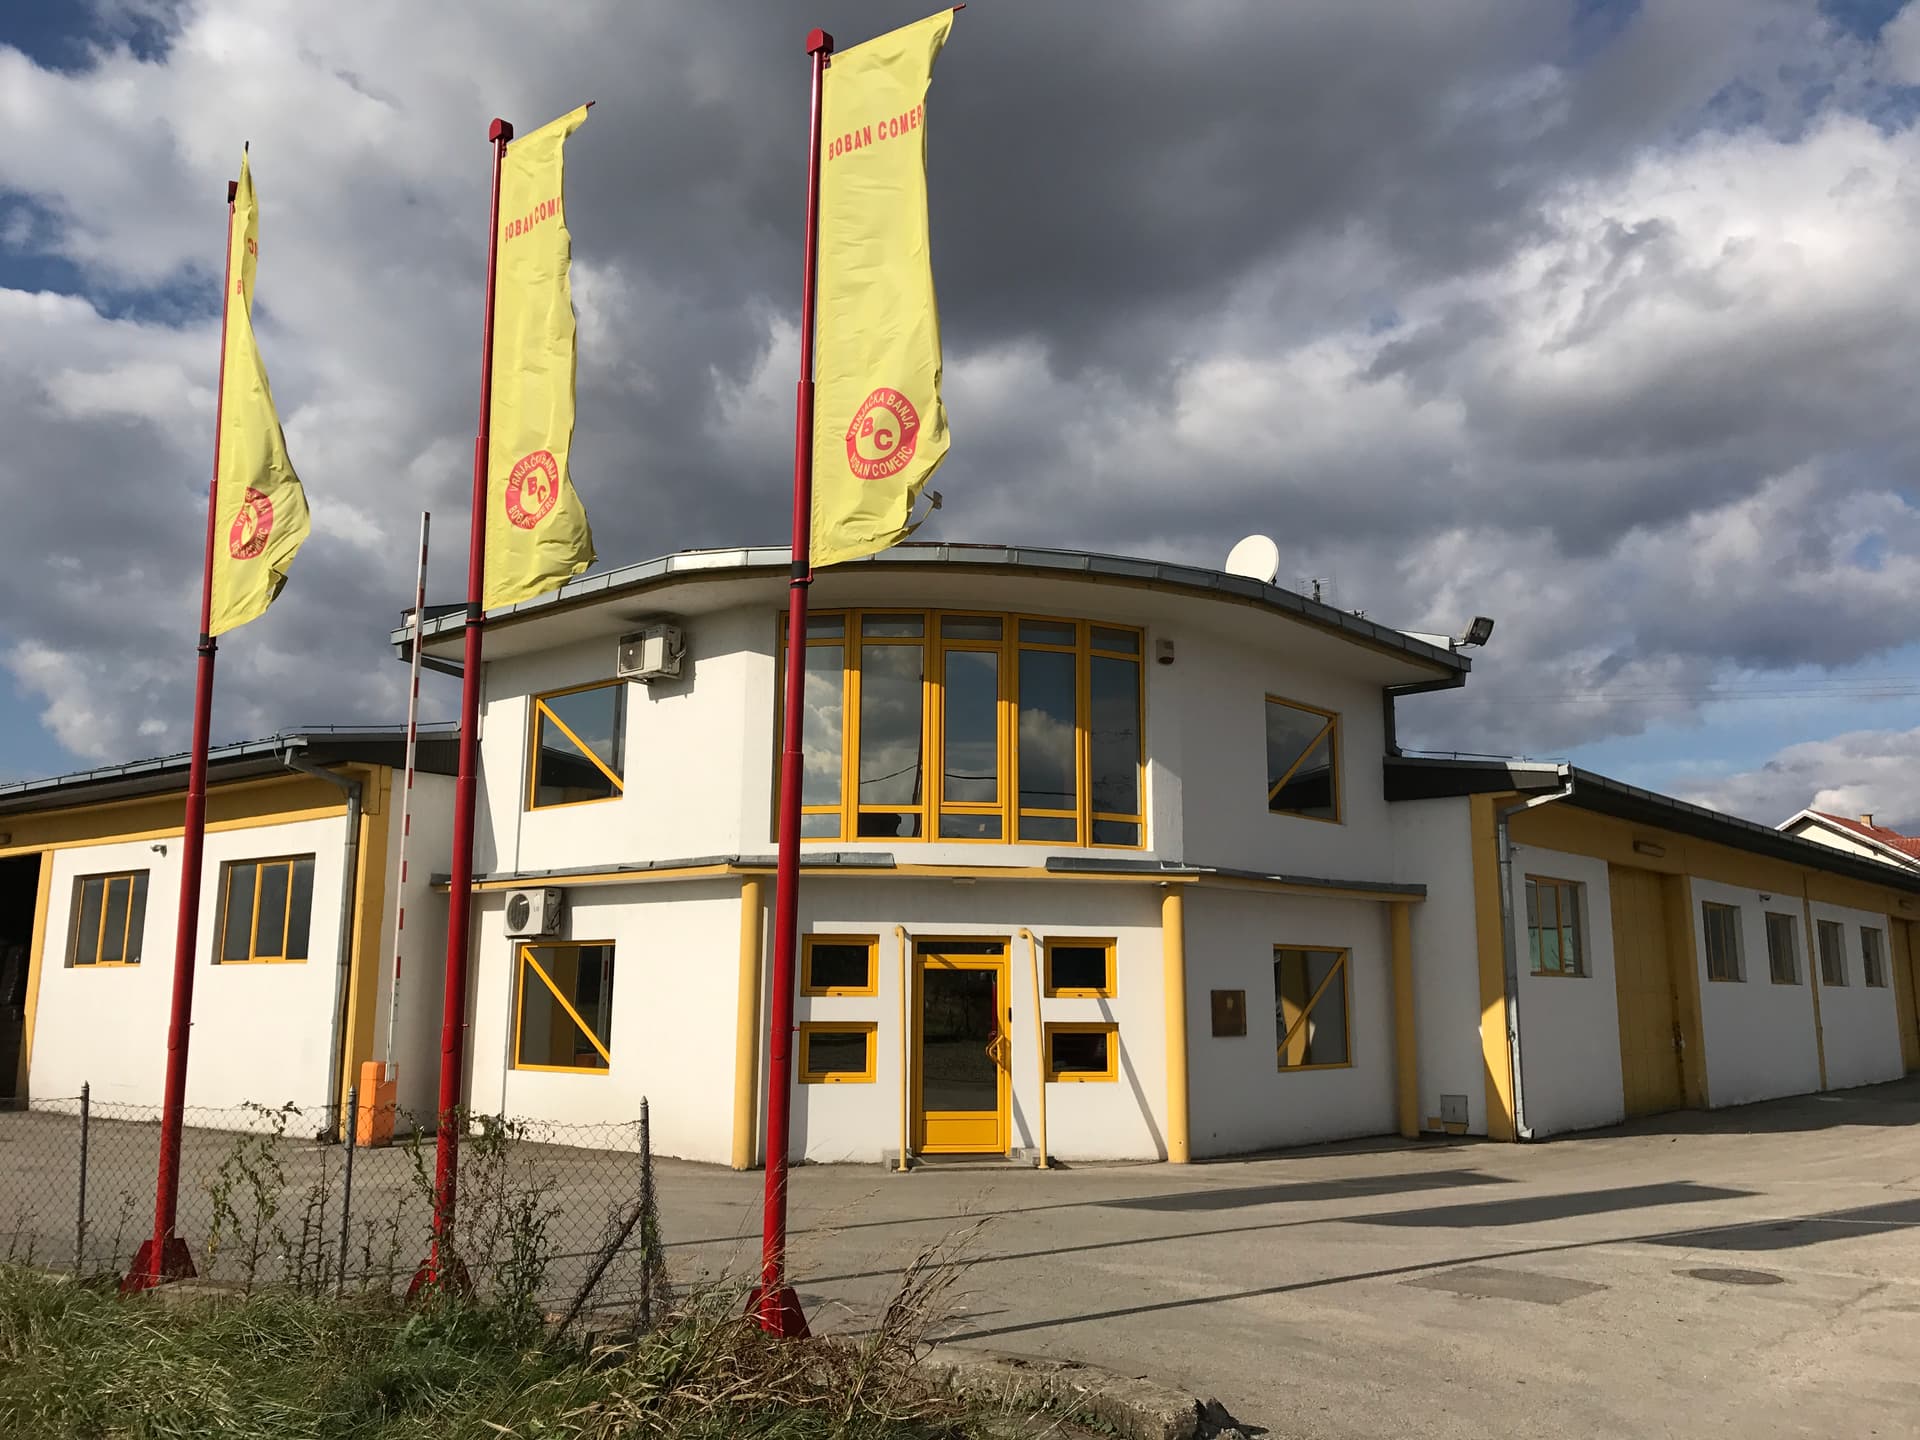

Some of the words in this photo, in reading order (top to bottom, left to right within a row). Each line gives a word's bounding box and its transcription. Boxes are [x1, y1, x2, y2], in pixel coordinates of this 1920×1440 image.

[828, 124, 872, 161] BOBAN
[886, 394, 916, 430] BANJA
[874, 428, 893, 451] C
[871, 446, 913, 477] COMERC
